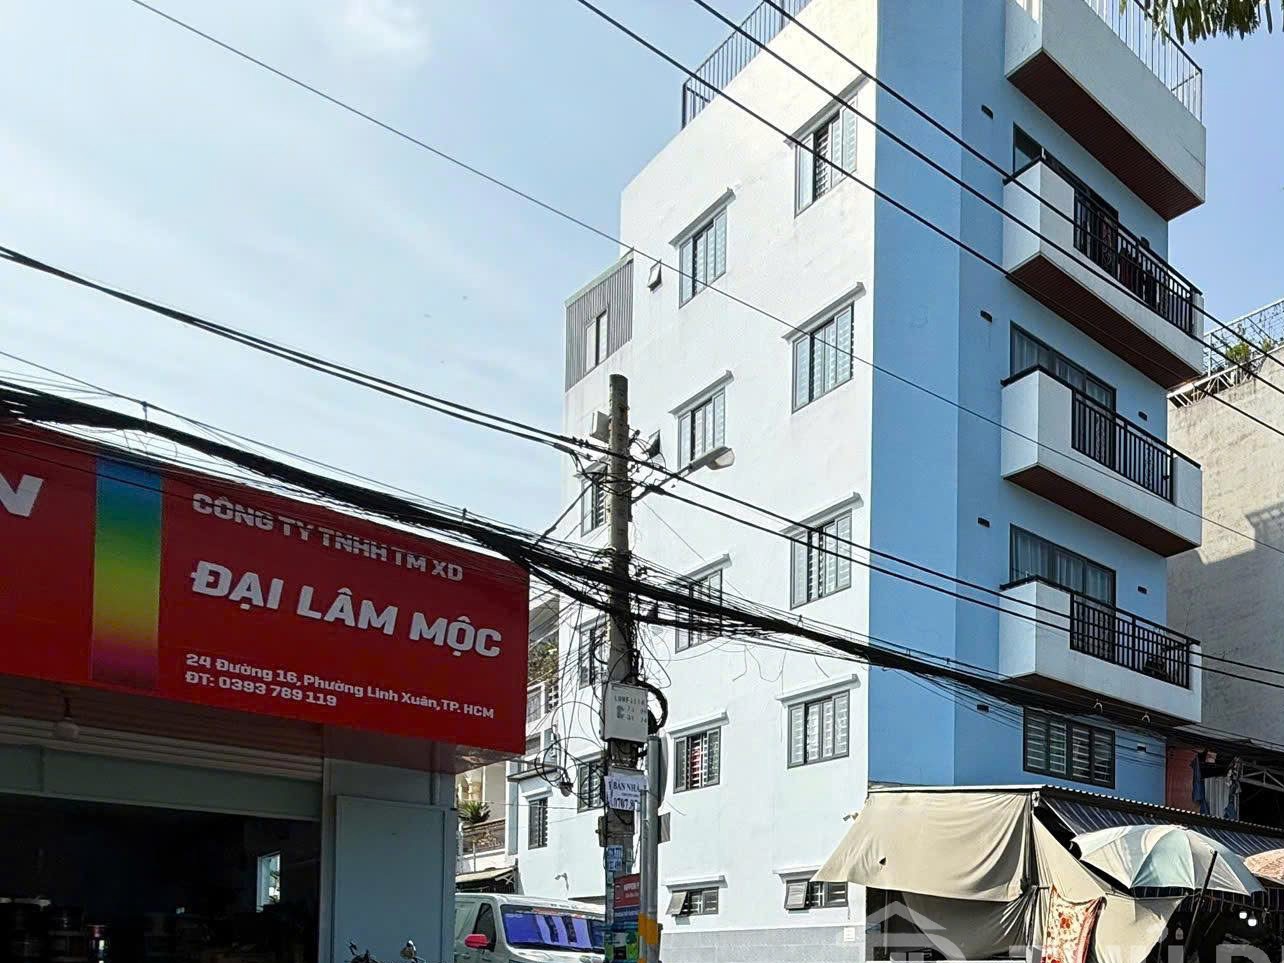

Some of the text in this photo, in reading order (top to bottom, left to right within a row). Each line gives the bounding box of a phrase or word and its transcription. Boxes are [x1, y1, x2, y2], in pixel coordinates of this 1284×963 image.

[192, 493, 463, 582] CÔNG TY TNHH TM XD
[190, 560, 502, 657] ĐẠI LÂM MỘC
[185, 670, 337, 707] ĐT: 0393 789 119
[186, 653, 211, 669] 24
[215, 658, 273, 682] Đường
[276, 669, 302, 686] 16,
[303, 674, 364, 698] Phường
[367, 685, 399, 702] Linh
[463, 703, 494, 719] HCM
